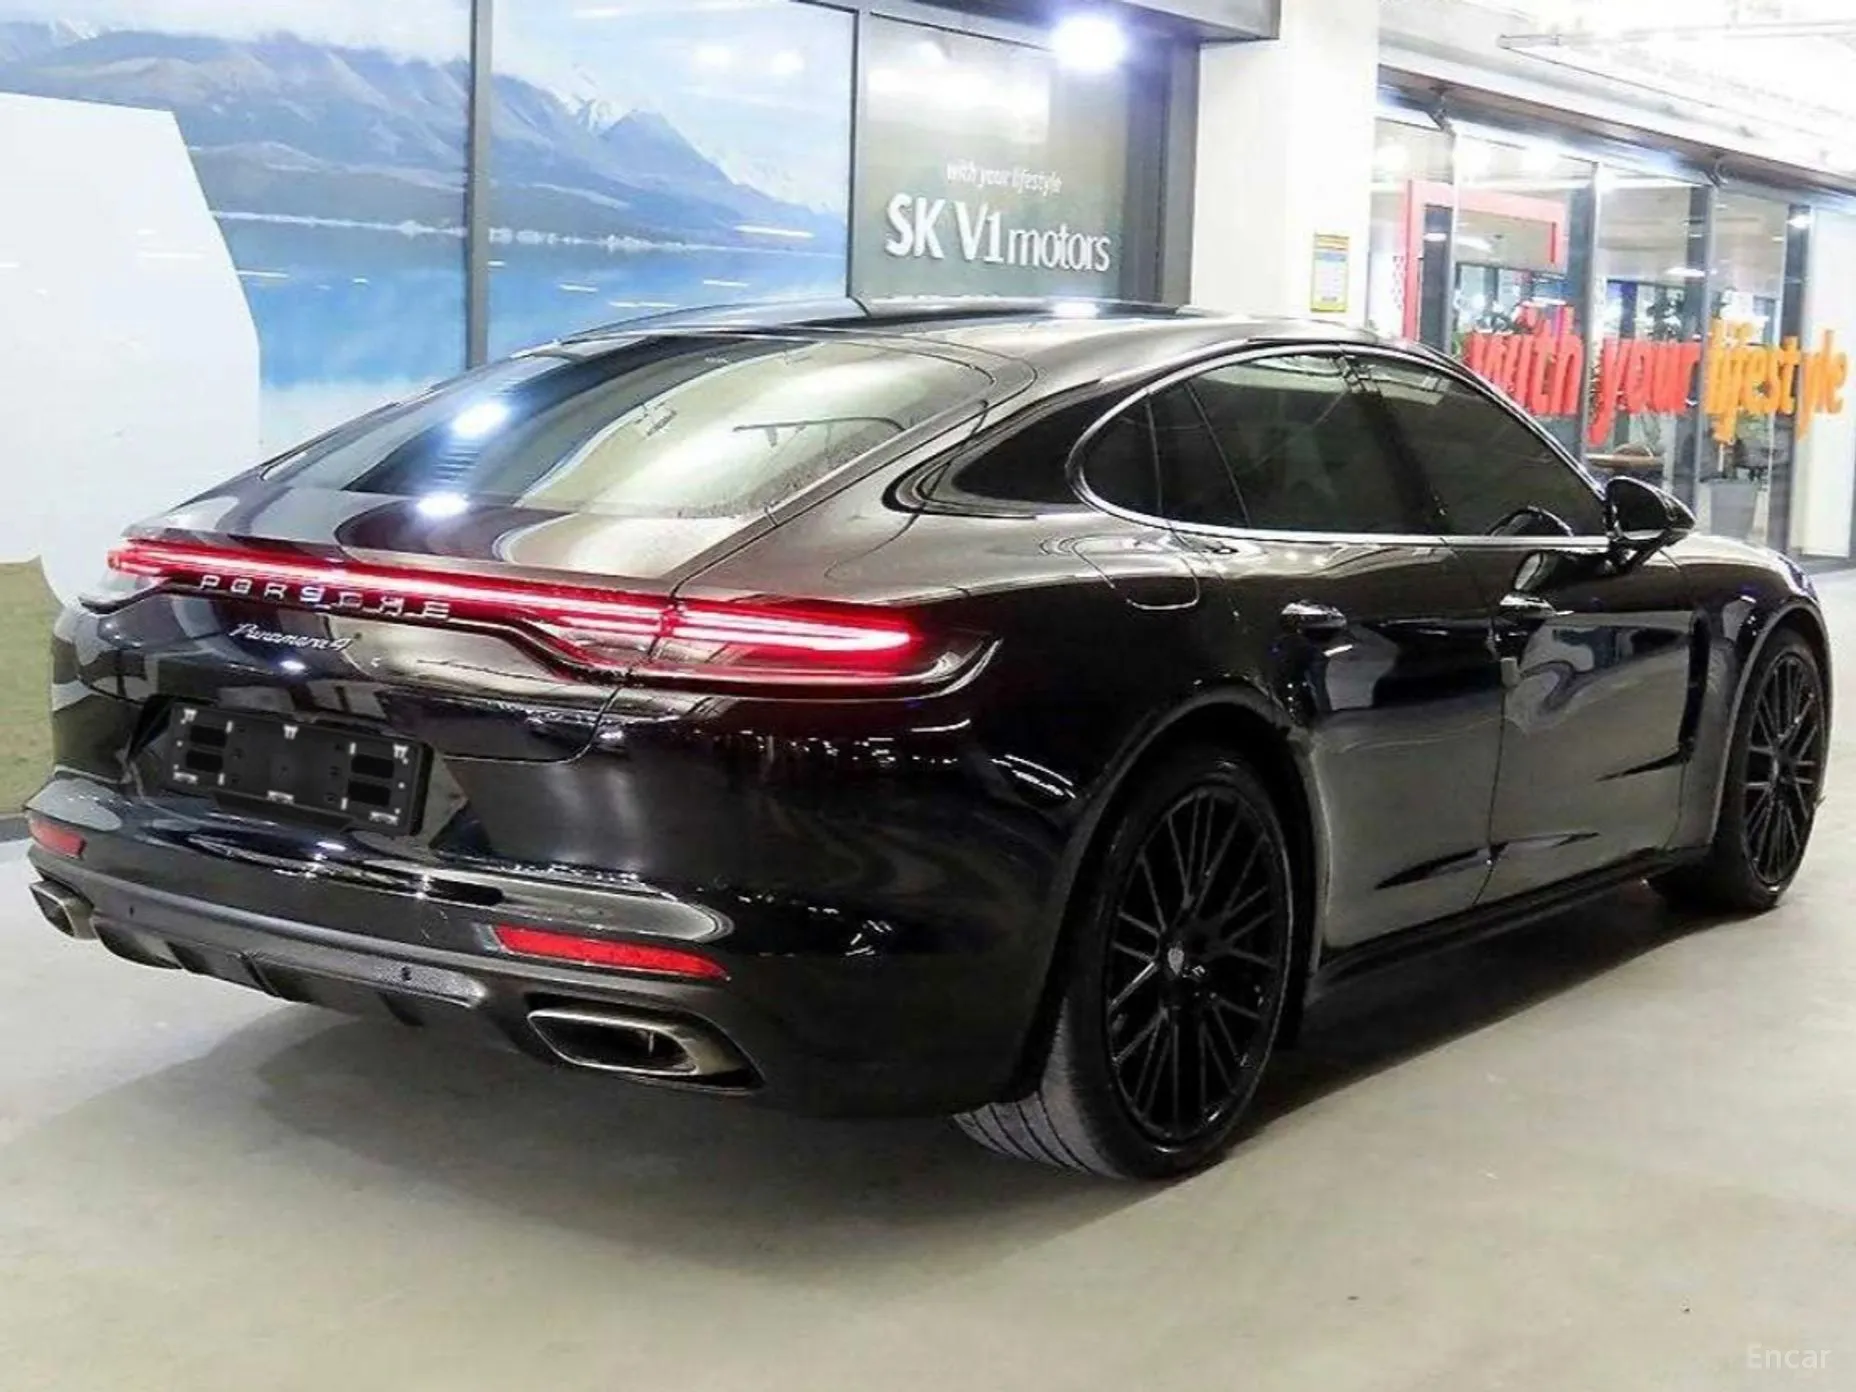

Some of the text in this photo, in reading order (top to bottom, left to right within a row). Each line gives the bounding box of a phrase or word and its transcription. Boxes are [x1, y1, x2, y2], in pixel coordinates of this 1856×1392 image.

[885, 192, 945, 260] SK
[1464, 303, 1583, 416] with
[1588, 335, 1700, 446] your
[199, 574, 452, 621] PORSCHE
